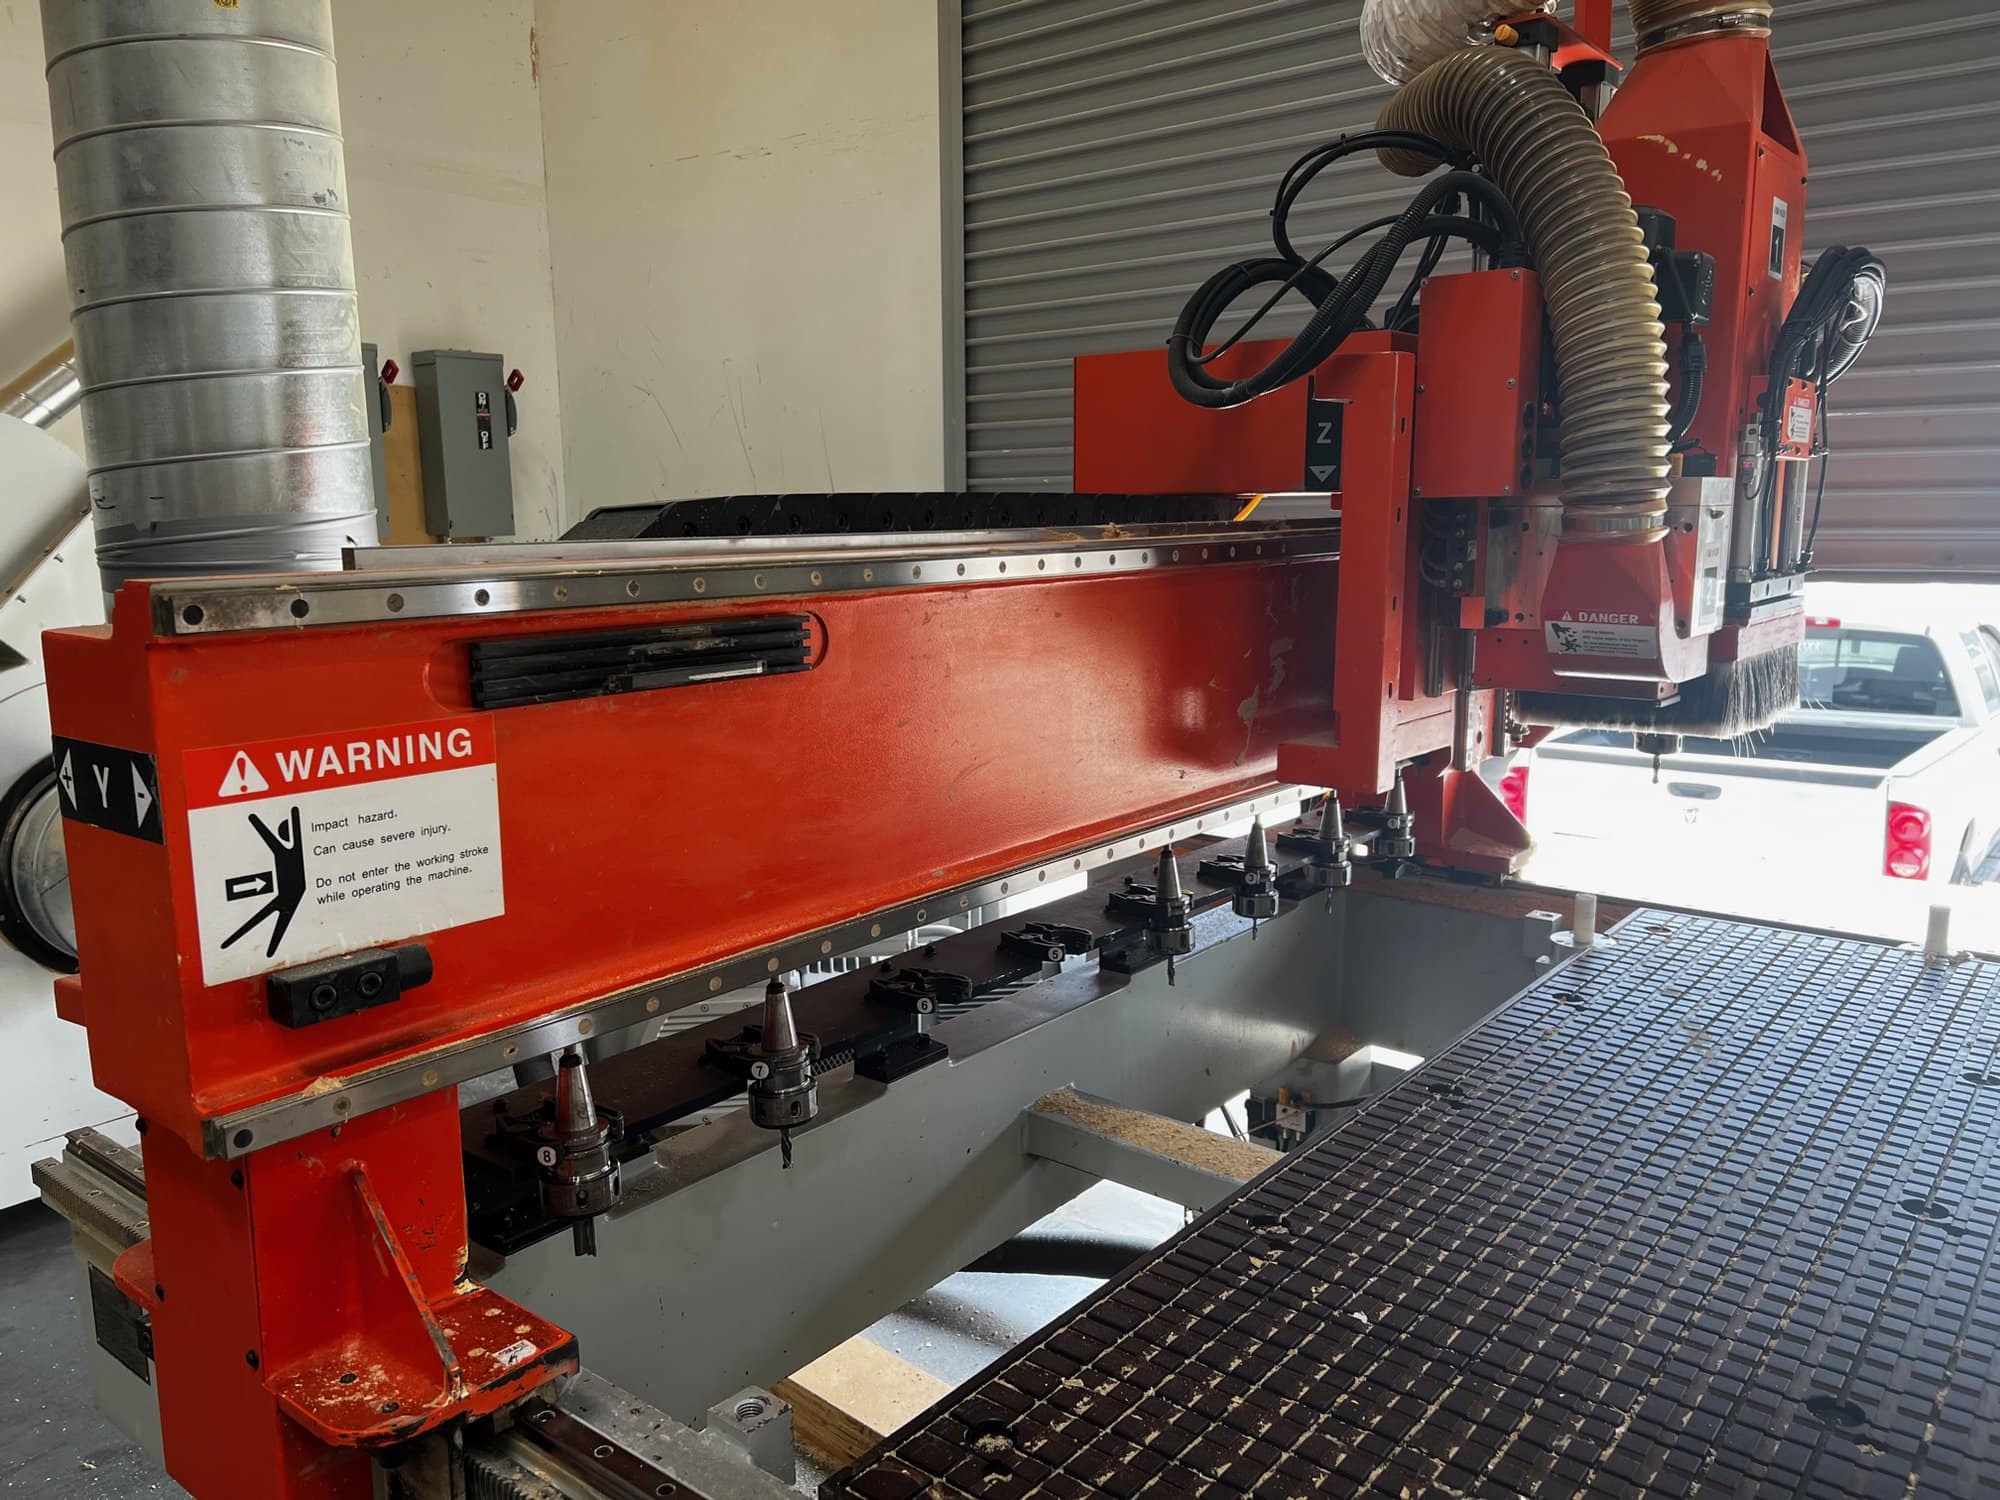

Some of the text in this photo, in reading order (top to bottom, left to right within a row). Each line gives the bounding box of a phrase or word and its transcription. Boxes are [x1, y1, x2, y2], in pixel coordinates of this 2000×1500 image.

[1316, 422, 1333, 444] Z
[1578, 611, 1640, 625] DANGER
[275, 728, 473, 783] WARNING
[92, 763, 110, 809] Y
[311, 809, 398, 833] Impact hazard.
[313, 824, 452, 857] Can cause severe injury.
[316, 846, 489, 889] Do not enter the working stroke
[316, 866, 473, 905] while operating the machine.
